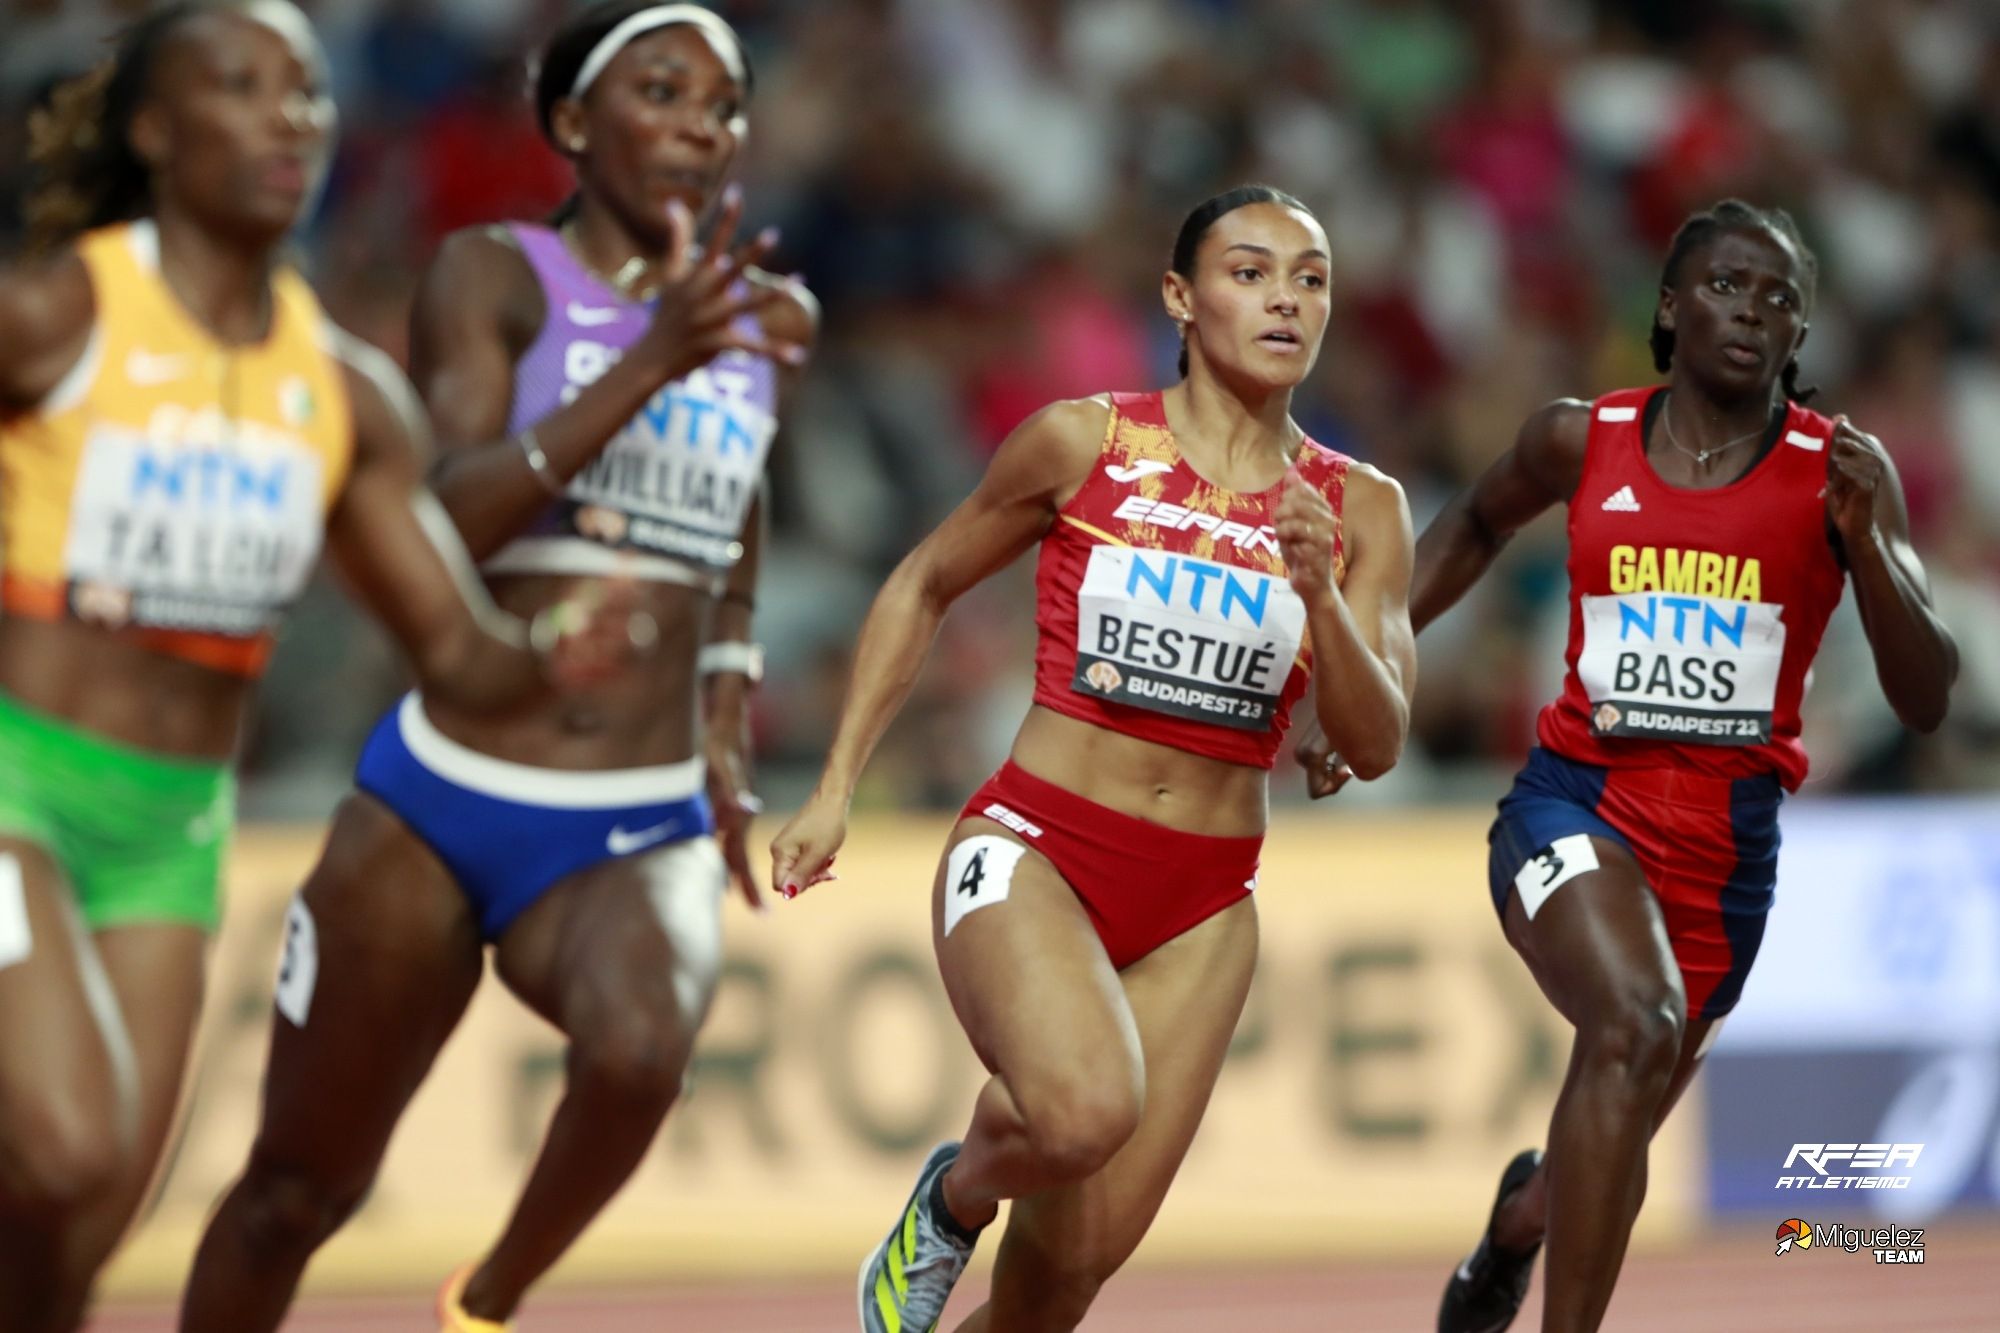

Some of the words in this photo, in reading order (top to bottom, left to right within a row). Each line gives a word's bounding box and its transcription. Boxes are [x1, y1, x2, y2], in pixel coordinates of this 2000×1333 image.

[131, 449, 288, 508] NTN
[1112, 495, 1280, 556] ESPAÑ
[1126, 552, 1270, 629] NTN
[1610, 545, 1761, 603] GAMBIA
[1618, 596, 1747, 649] NTN
[1097, 613, 1275, 690] BESTUÉ
[1613, 652, 1737, 702] BASS
[983, 803, 1043, 838] ESP
[957, 846, 989, 898] 4
[1533, 843, 1564, 887] 3
